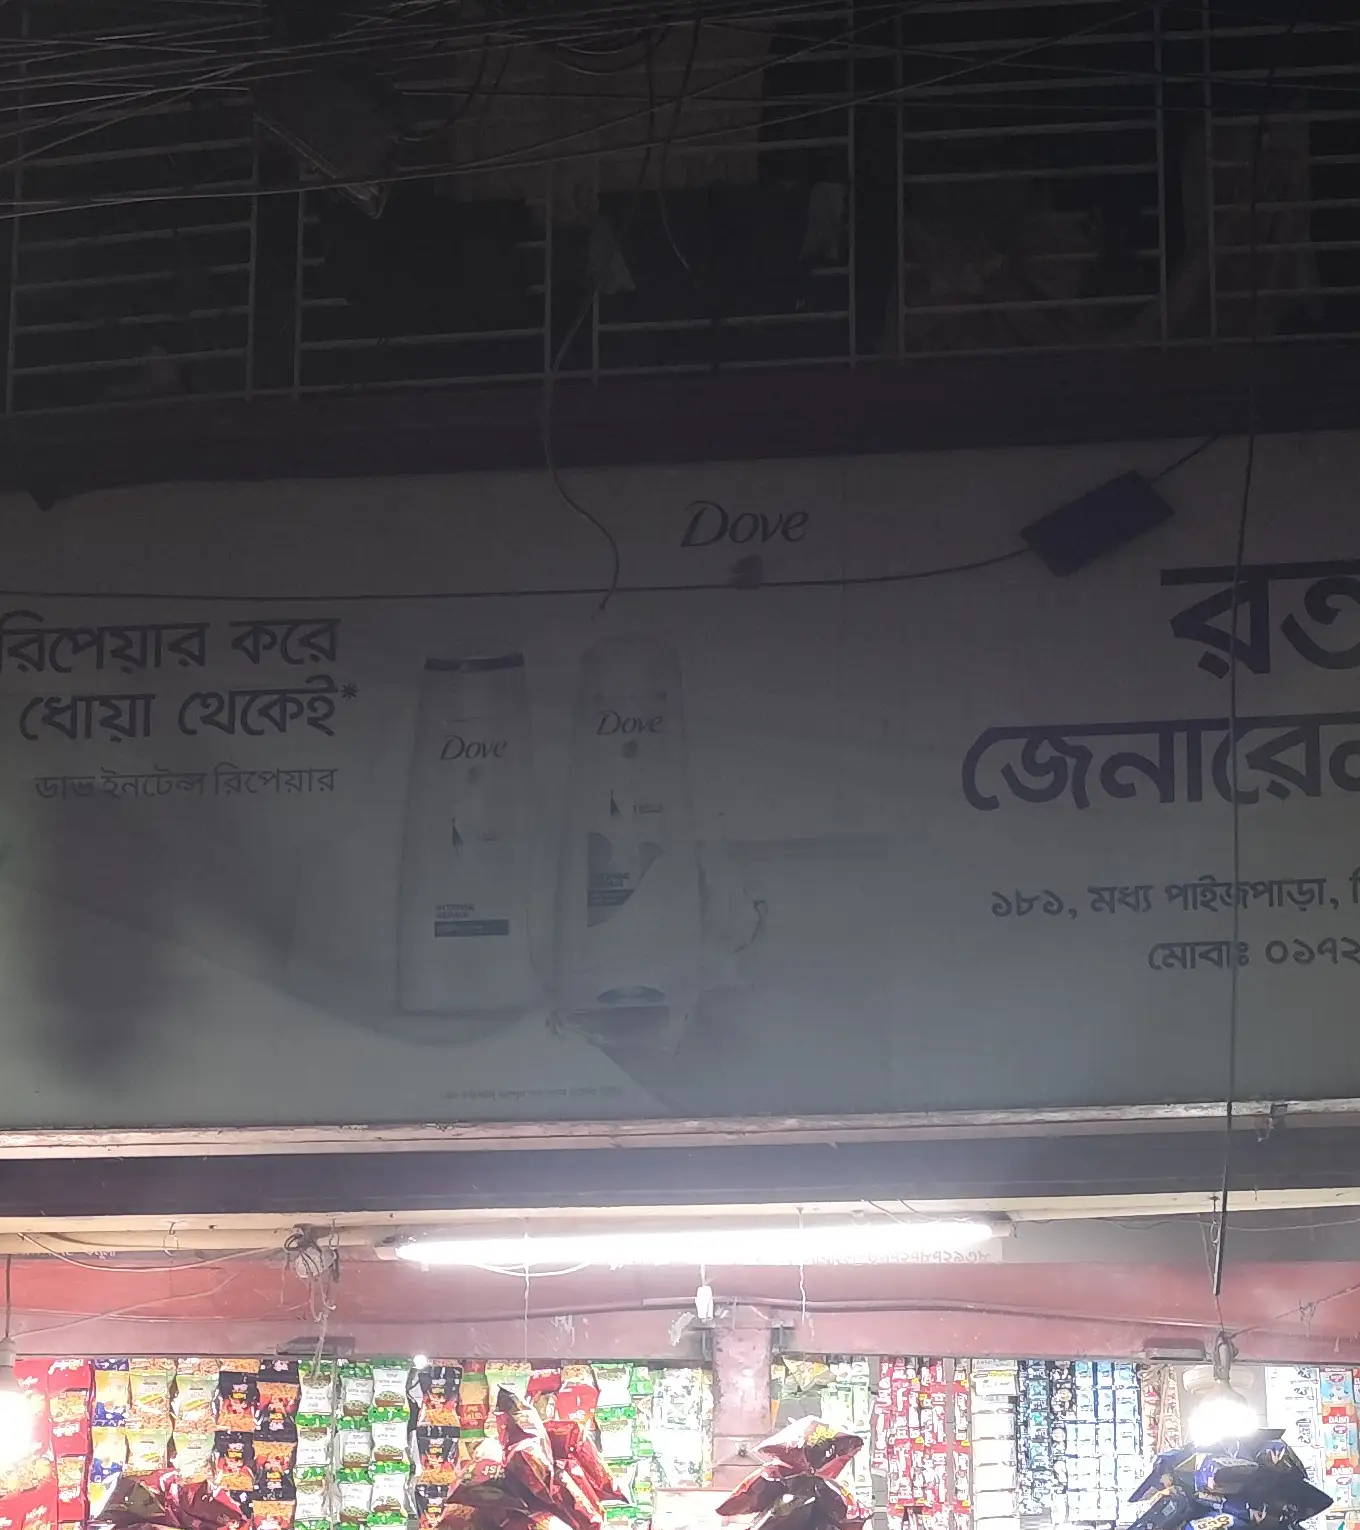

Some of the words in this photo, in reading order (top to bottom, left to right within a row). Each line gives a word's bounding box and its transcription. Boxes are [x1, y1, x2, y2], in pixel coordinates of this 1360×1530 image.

[681, 499, 810, 550] Dove
[230, 617, 342, 665] করে
[19, 693, 156, 743] ধোয়া
[597, 709, 664, 736] Dove
[439, 733, 508, 763] Dove
[34, 770, 96, 799] ডাভ
[100, 764, 207, 798] ইনটেন্স
[212, 761, 342, 796] রিপেয়ার
[990, 887, 1078, 921] ১৮১,
[1089, 884, 1152, 914] মধ্য
[1328, 1415, 1350, 1424] DANO
[1331, 1466, 1354, 1477] DANO
